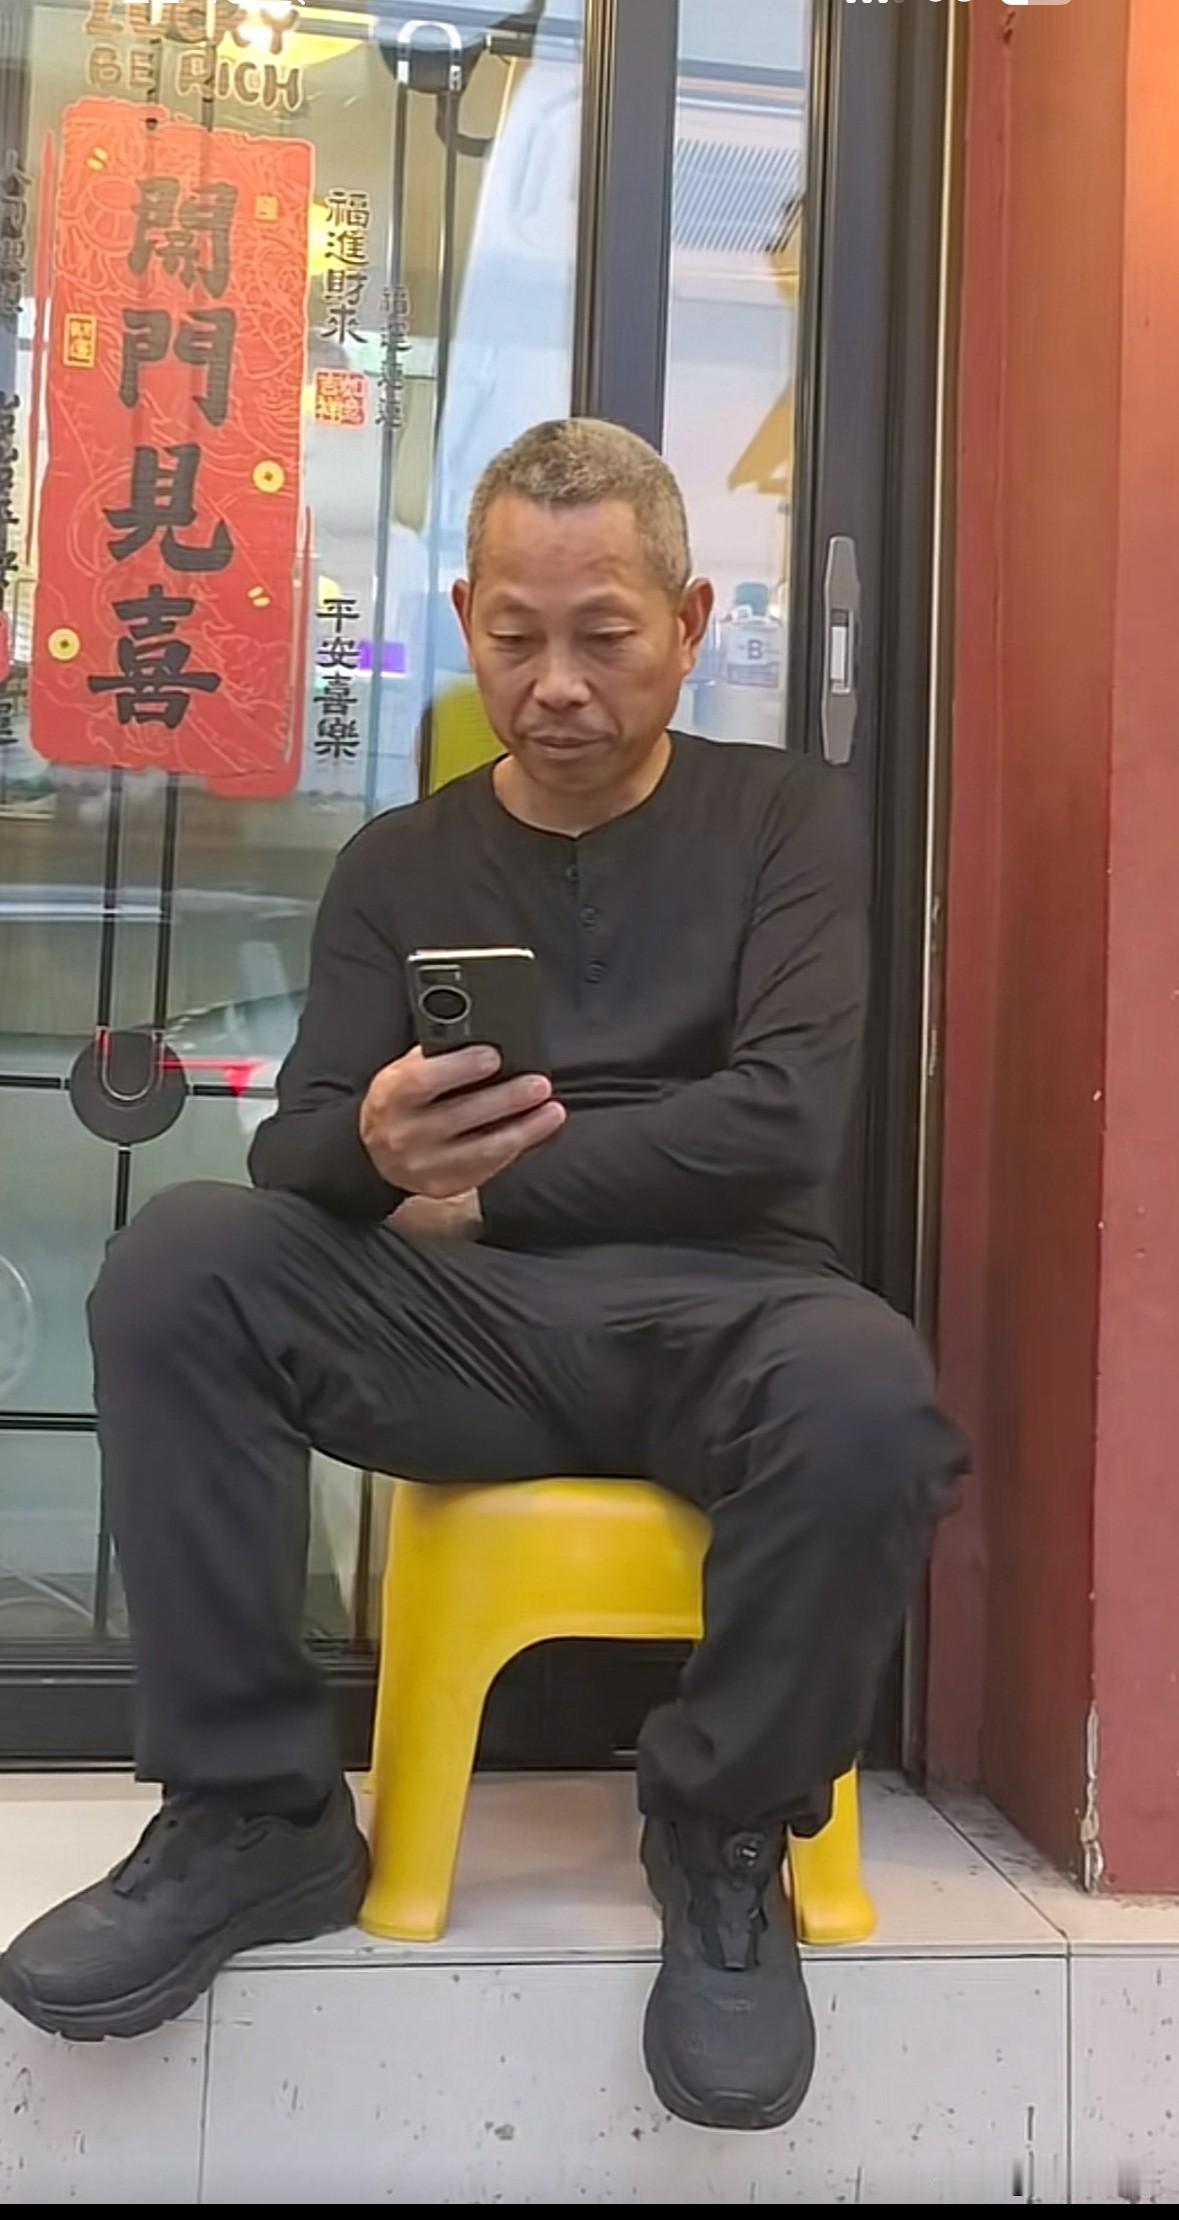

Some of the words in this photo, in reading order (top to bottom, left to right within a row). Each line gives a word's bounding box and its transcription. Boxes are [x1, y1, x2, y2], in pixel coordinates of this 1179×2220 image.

[89, 46, 156, 87] BE
[178, 52, 301, 109] RICH
[321, 190, 370, 344] 福進財來
[313, 599, 361, 759] 平安喜樂
